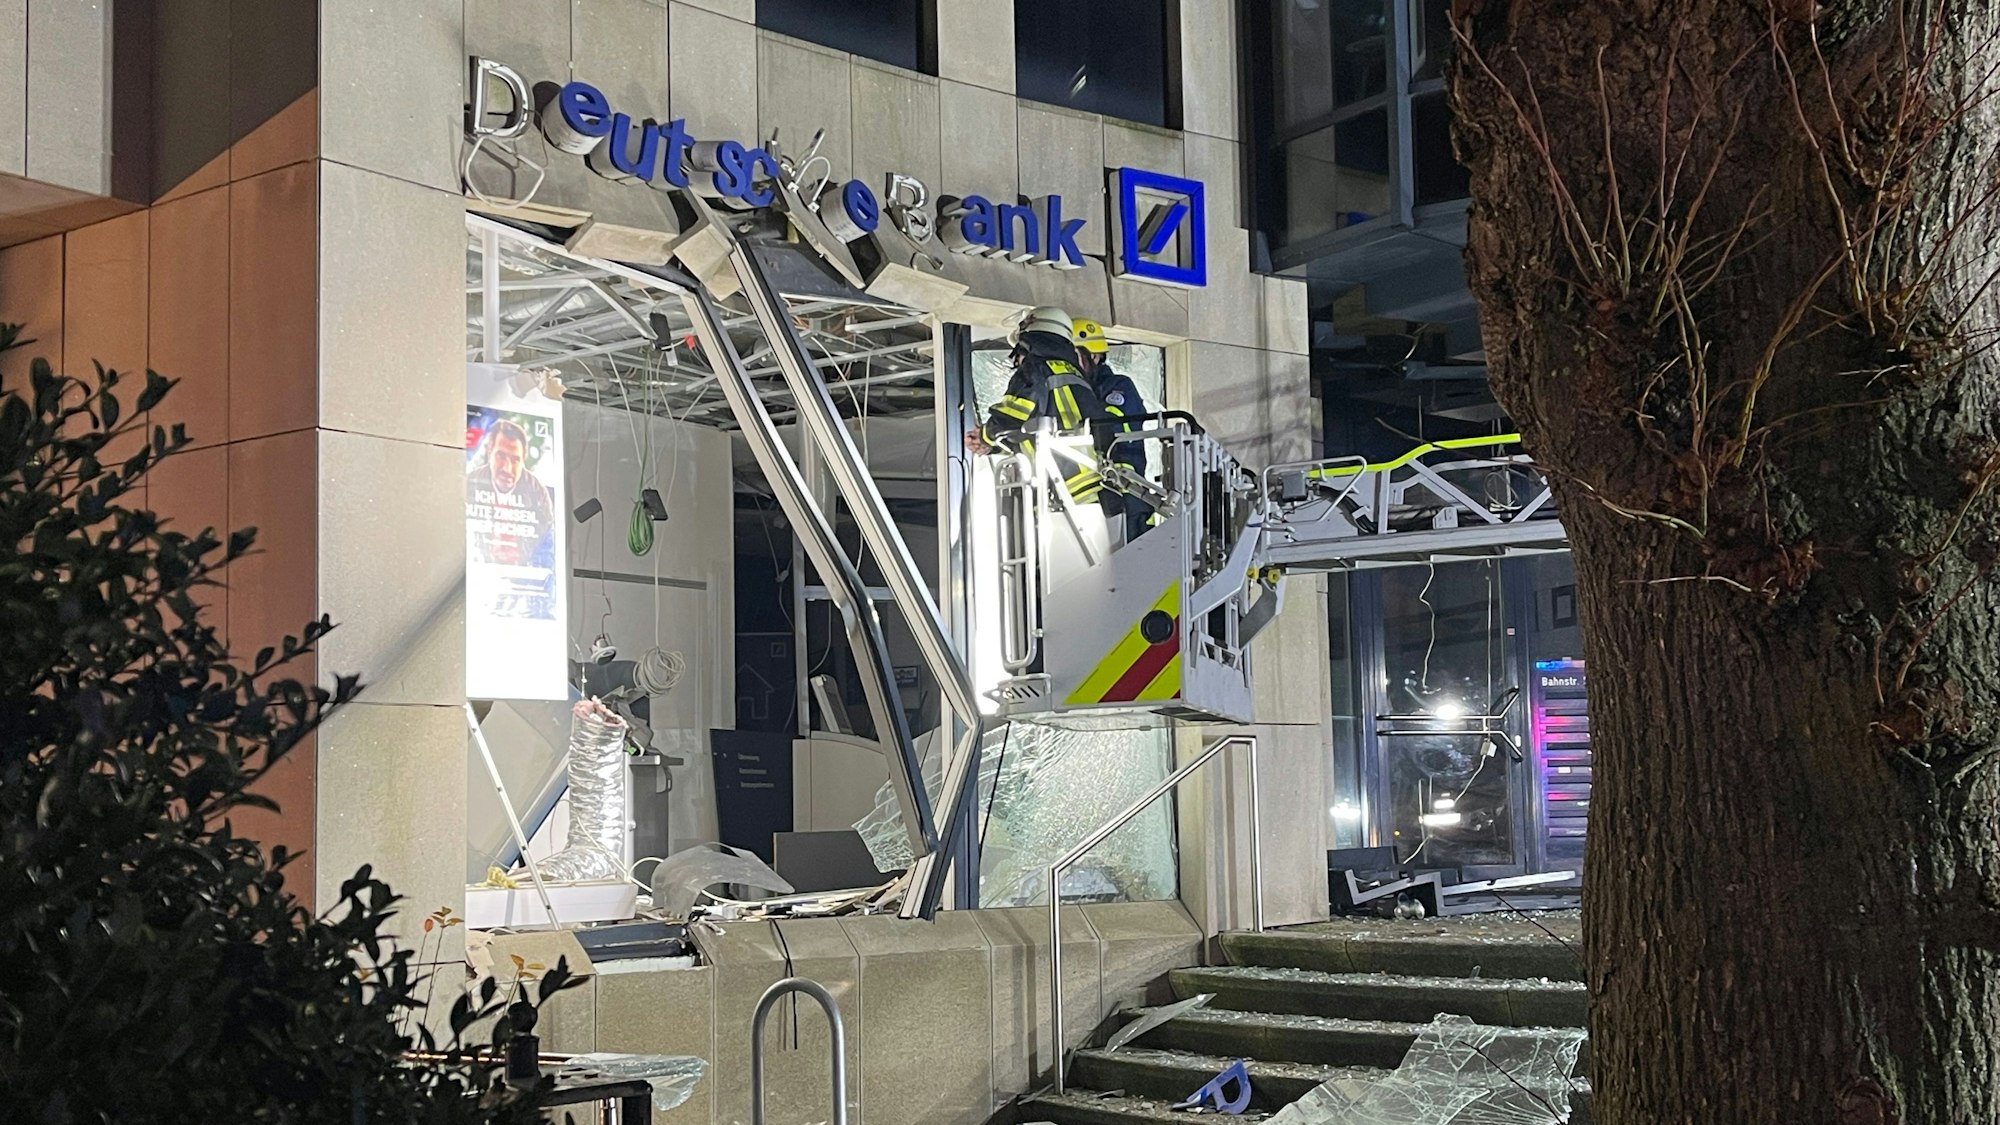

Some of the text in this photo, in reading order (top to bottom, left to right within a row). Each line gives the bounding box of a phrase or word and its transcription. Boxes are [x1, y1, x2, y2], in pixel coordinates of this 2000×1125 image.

[475, 489, 525, 507] ICH WILL
[1541, 676, 1580, 687] Bahnstr.
